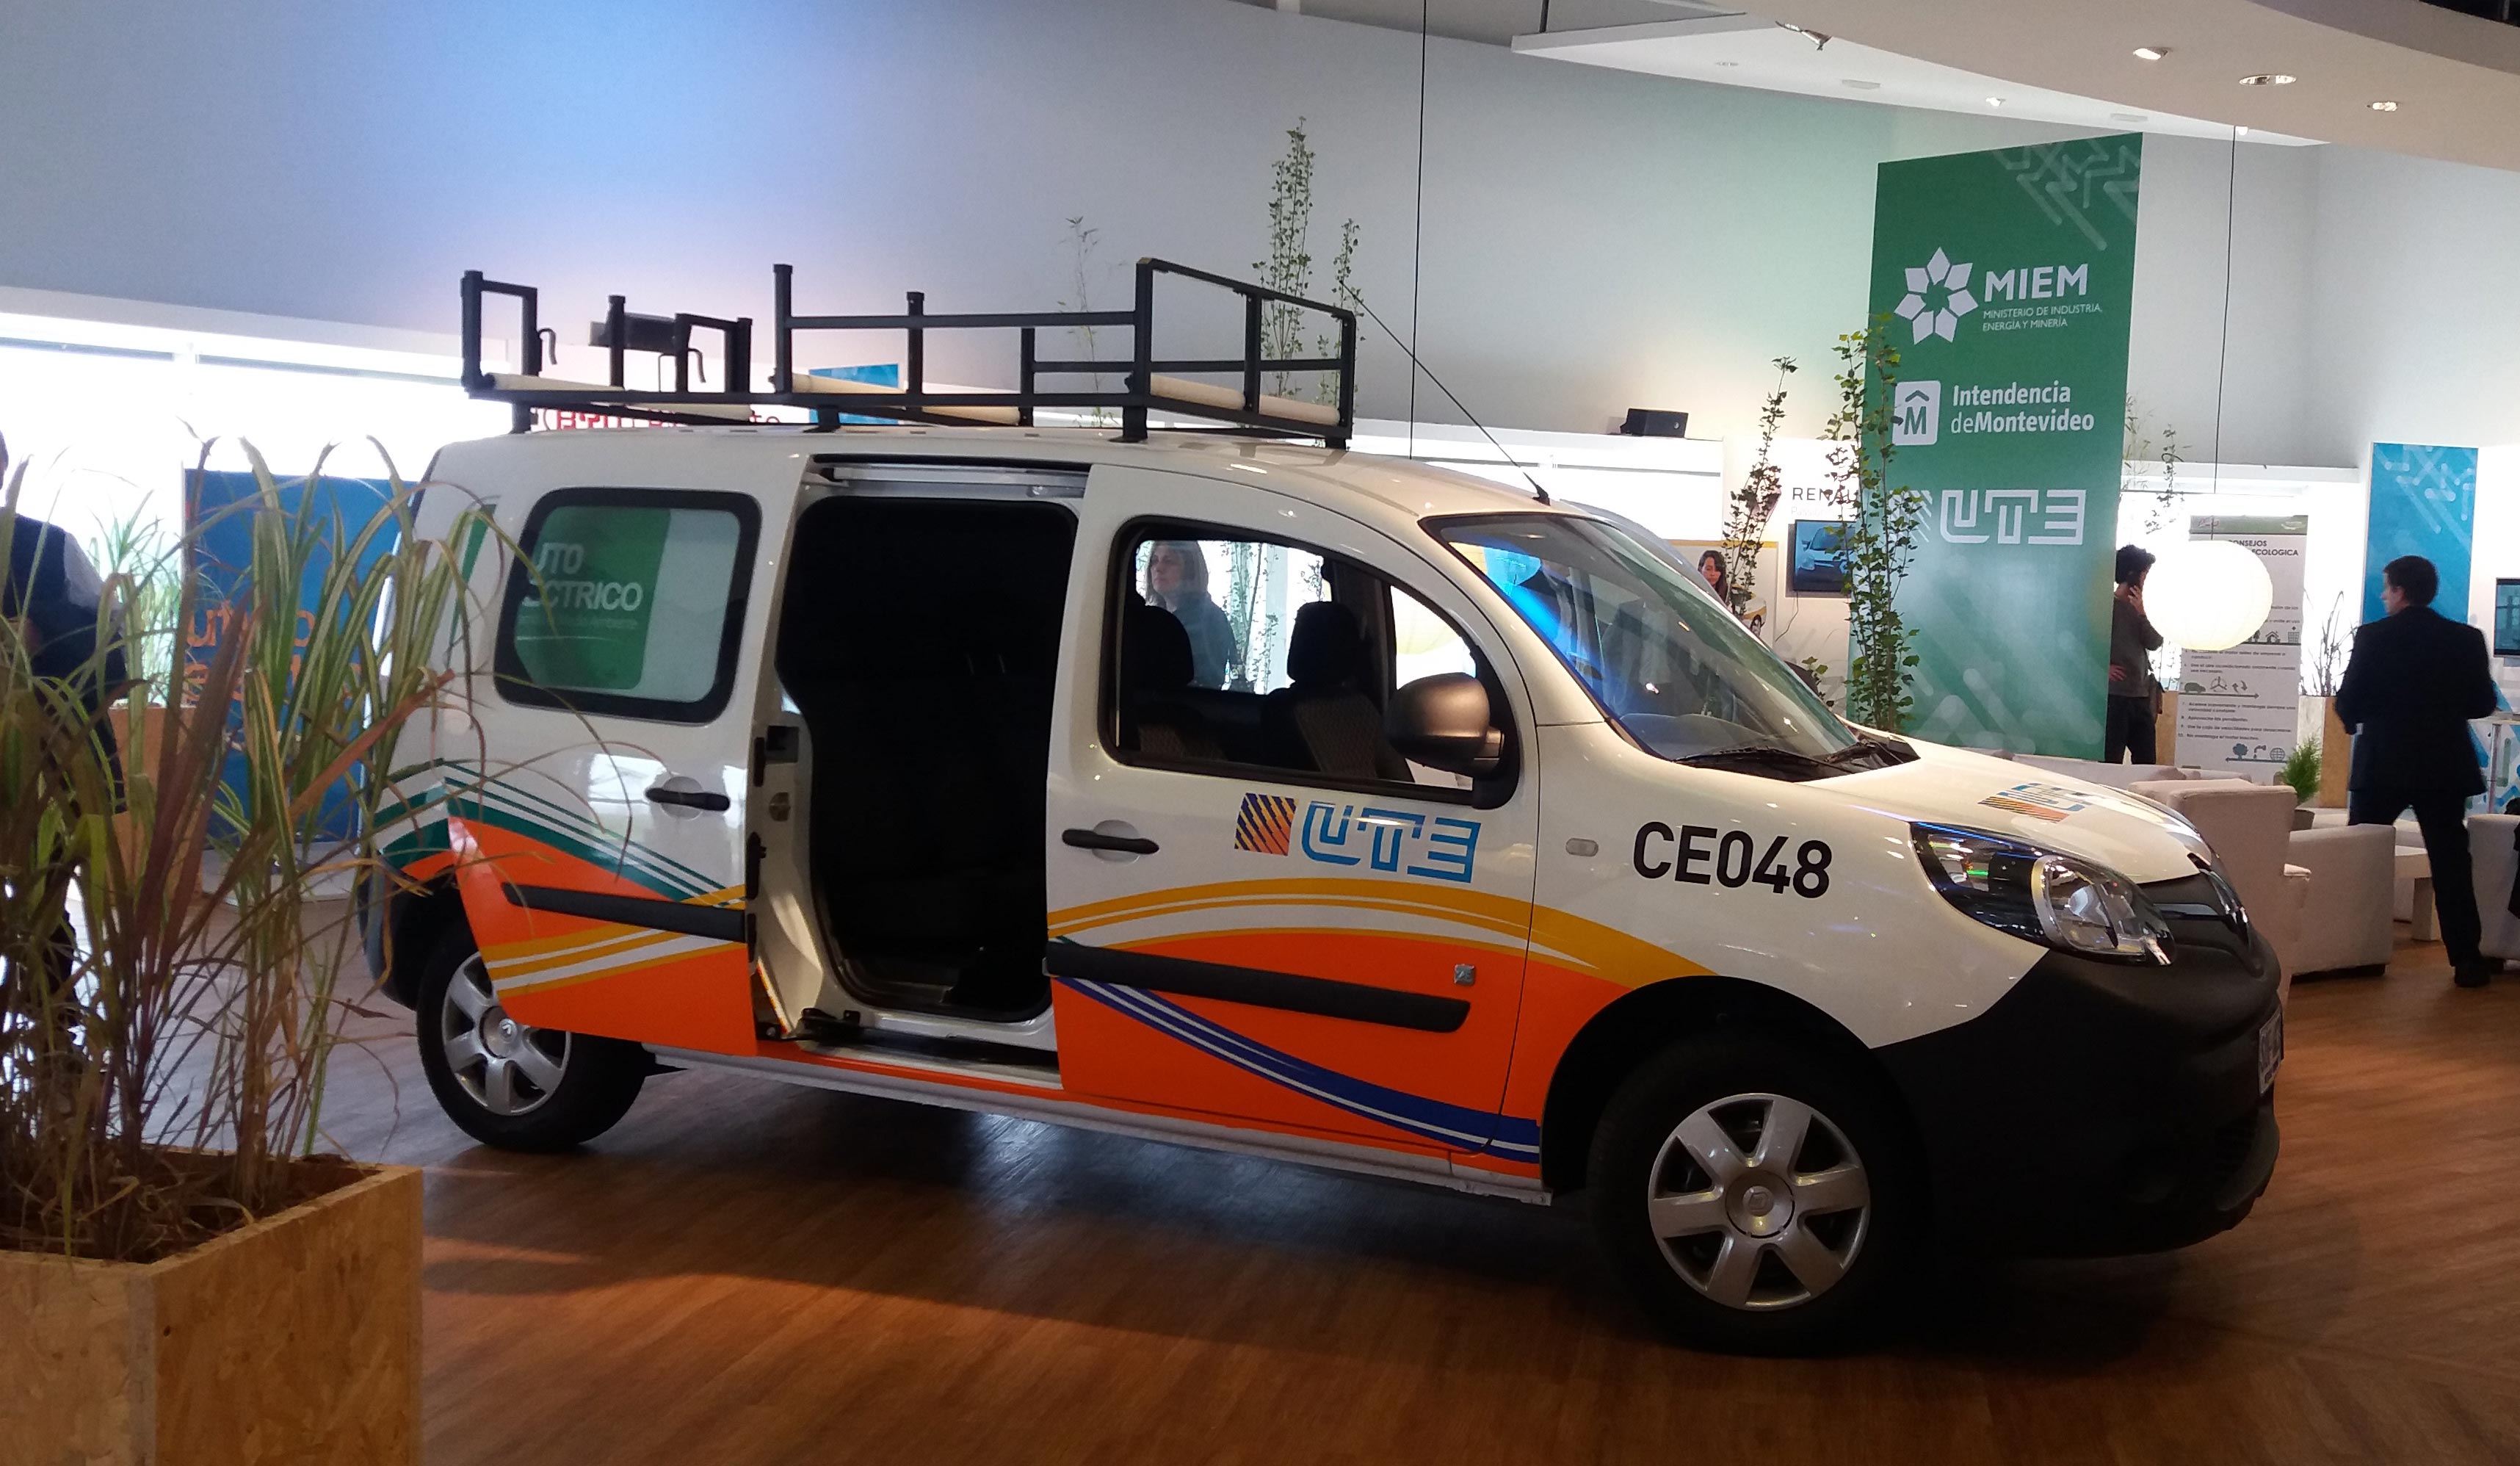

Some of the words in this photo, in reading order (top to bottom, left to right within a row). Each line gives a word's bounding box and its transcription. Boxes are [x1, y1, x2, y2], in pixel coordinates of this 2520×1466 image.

[1984, 264, 2088, 303] MIEM
[1983, 307, 2034, 319] MINISTERIO
[2036, 306, 2049, 317] DE
[2051, 303, 2103, 315] INDUSTRIA,
[2022, 320, 2029, 329] Y
[1953, 380, 2071, 406] Intendencia
[1950, 408, 2095, 434] deMontevideo
[1633, 820, 1833, 899] CE048
